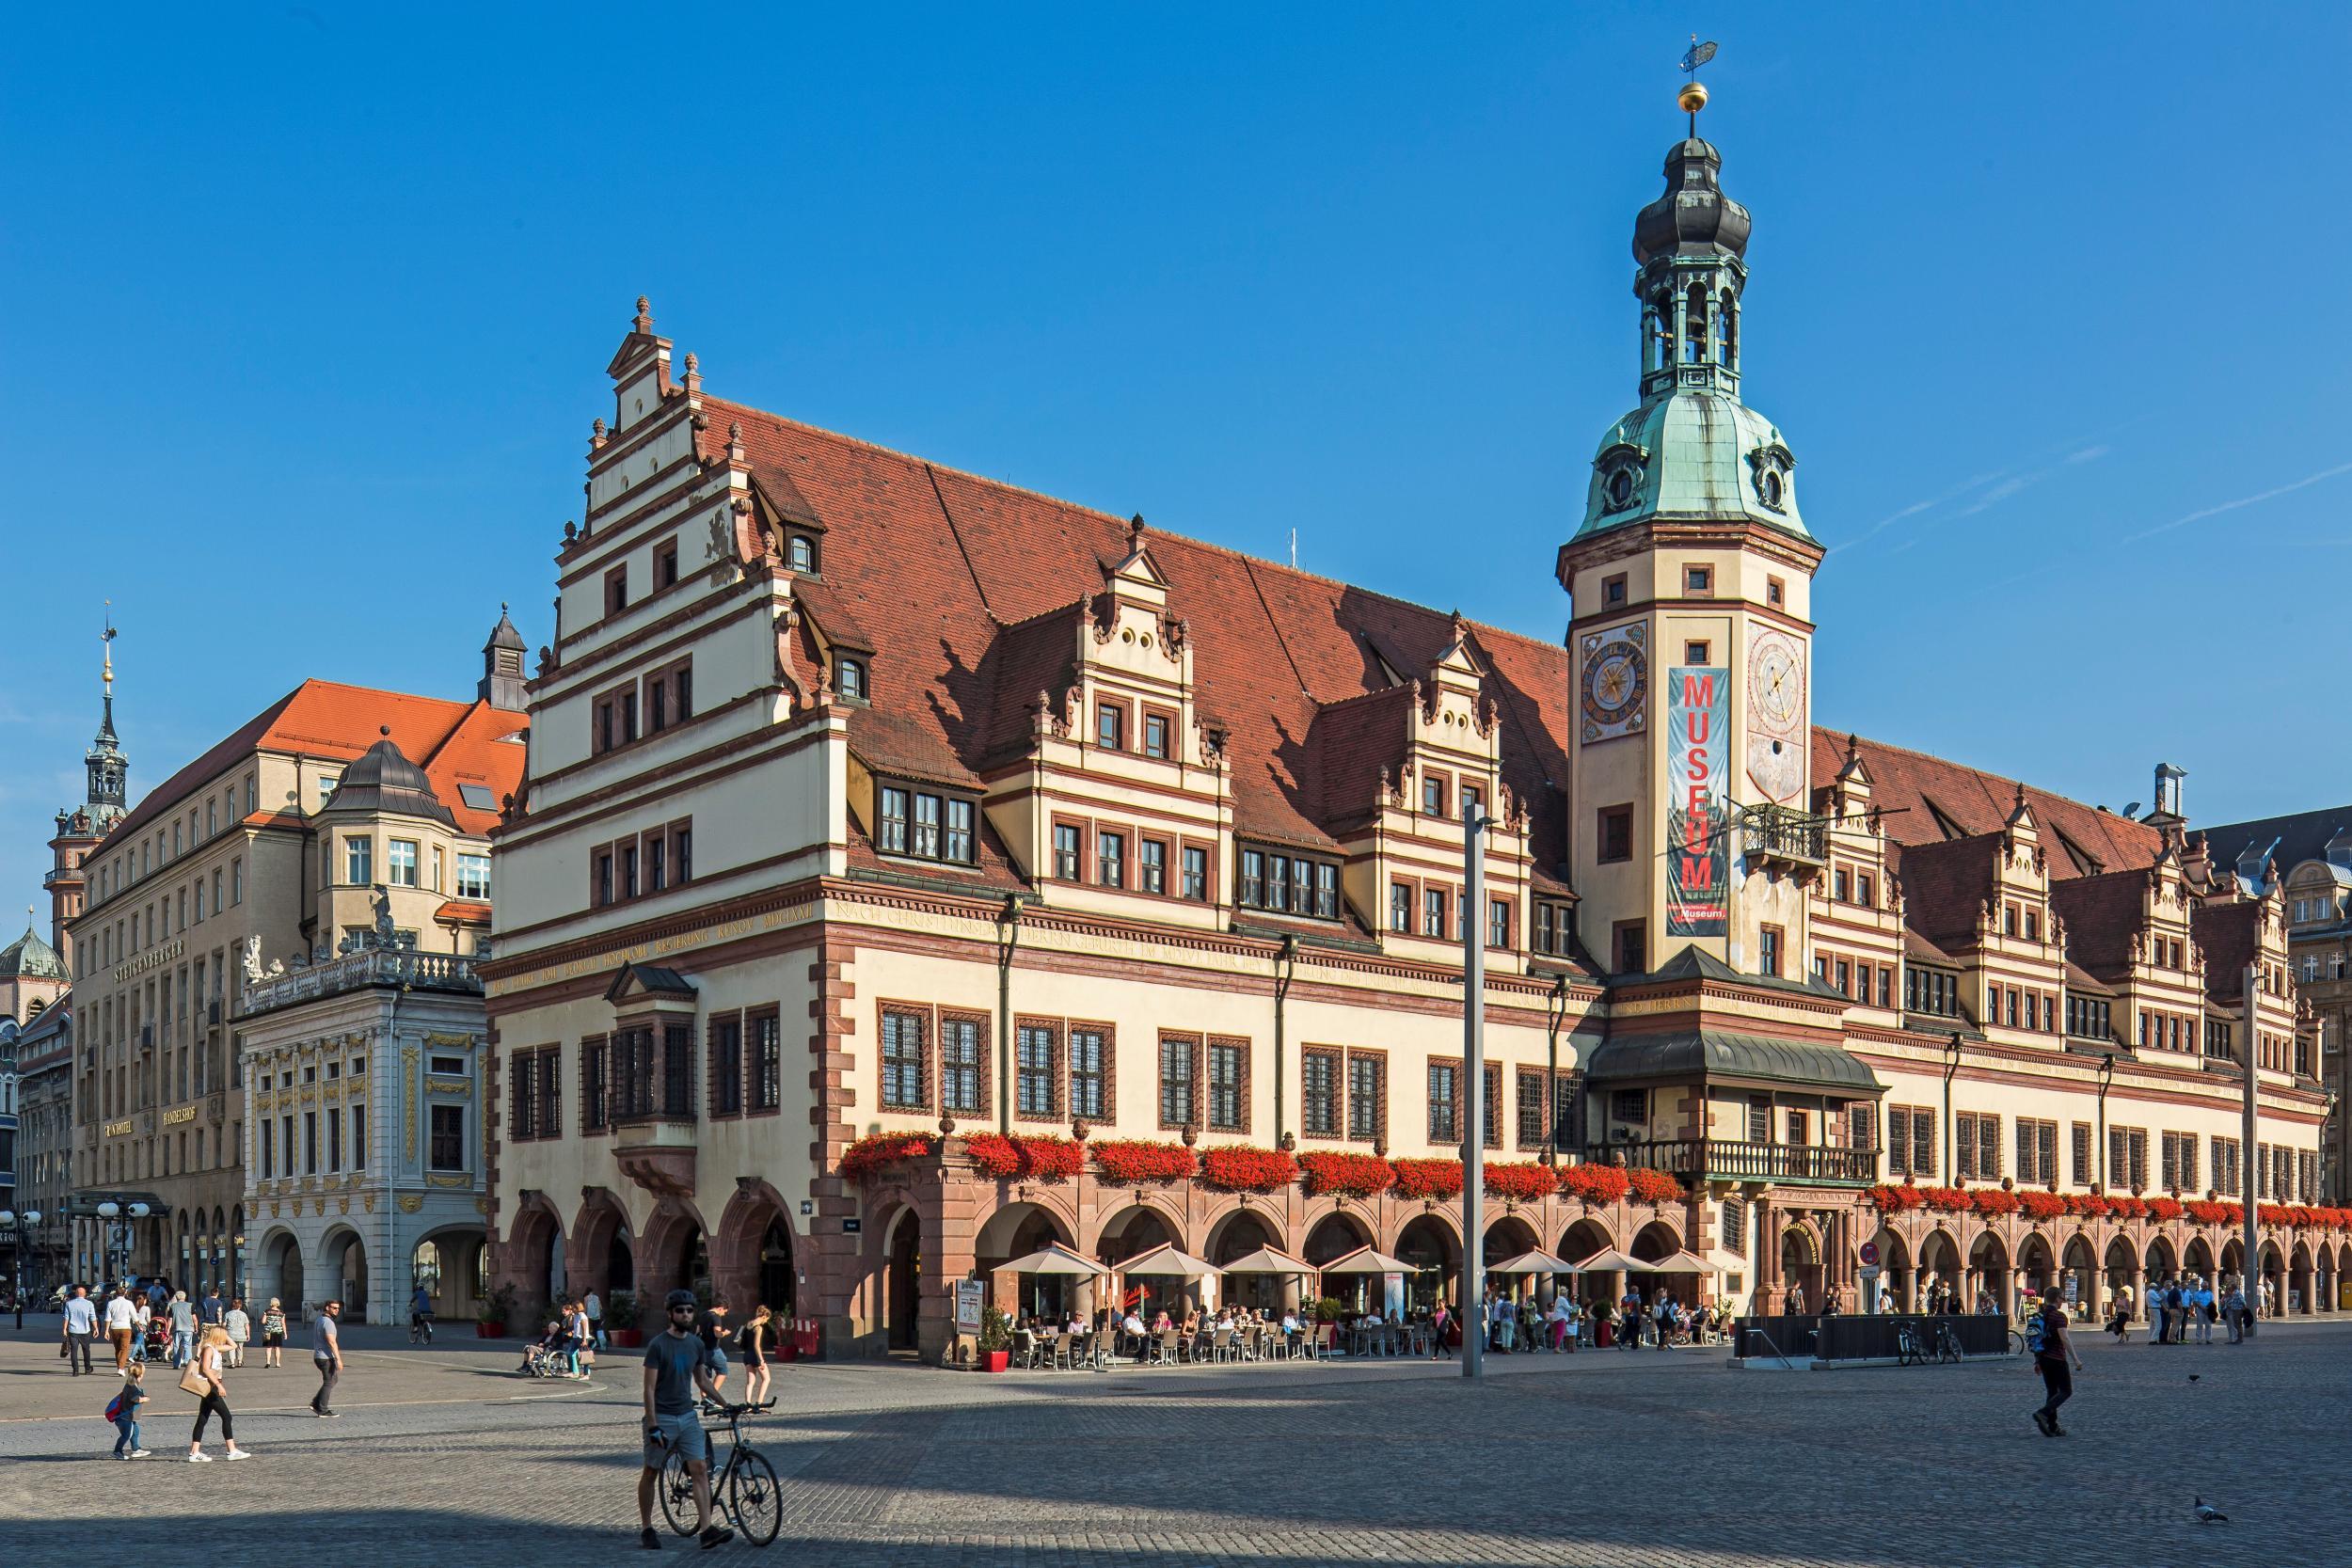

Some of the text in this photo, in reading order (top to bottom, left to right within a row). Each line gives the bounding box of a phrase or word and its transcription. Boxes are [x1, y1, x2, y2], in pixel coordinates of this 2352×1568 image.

[1682, 675, 1713, 891] MUSEUM
[835, 901, 881, 921] NACH
[655, 928, 708, 954] REGIERUNG
[114, 940, 183, 984] STEIGENBERGER
[1648, 997, 1693, 1013] HERRN
[163, 1106, 196, 1126] HANDELSHOF
